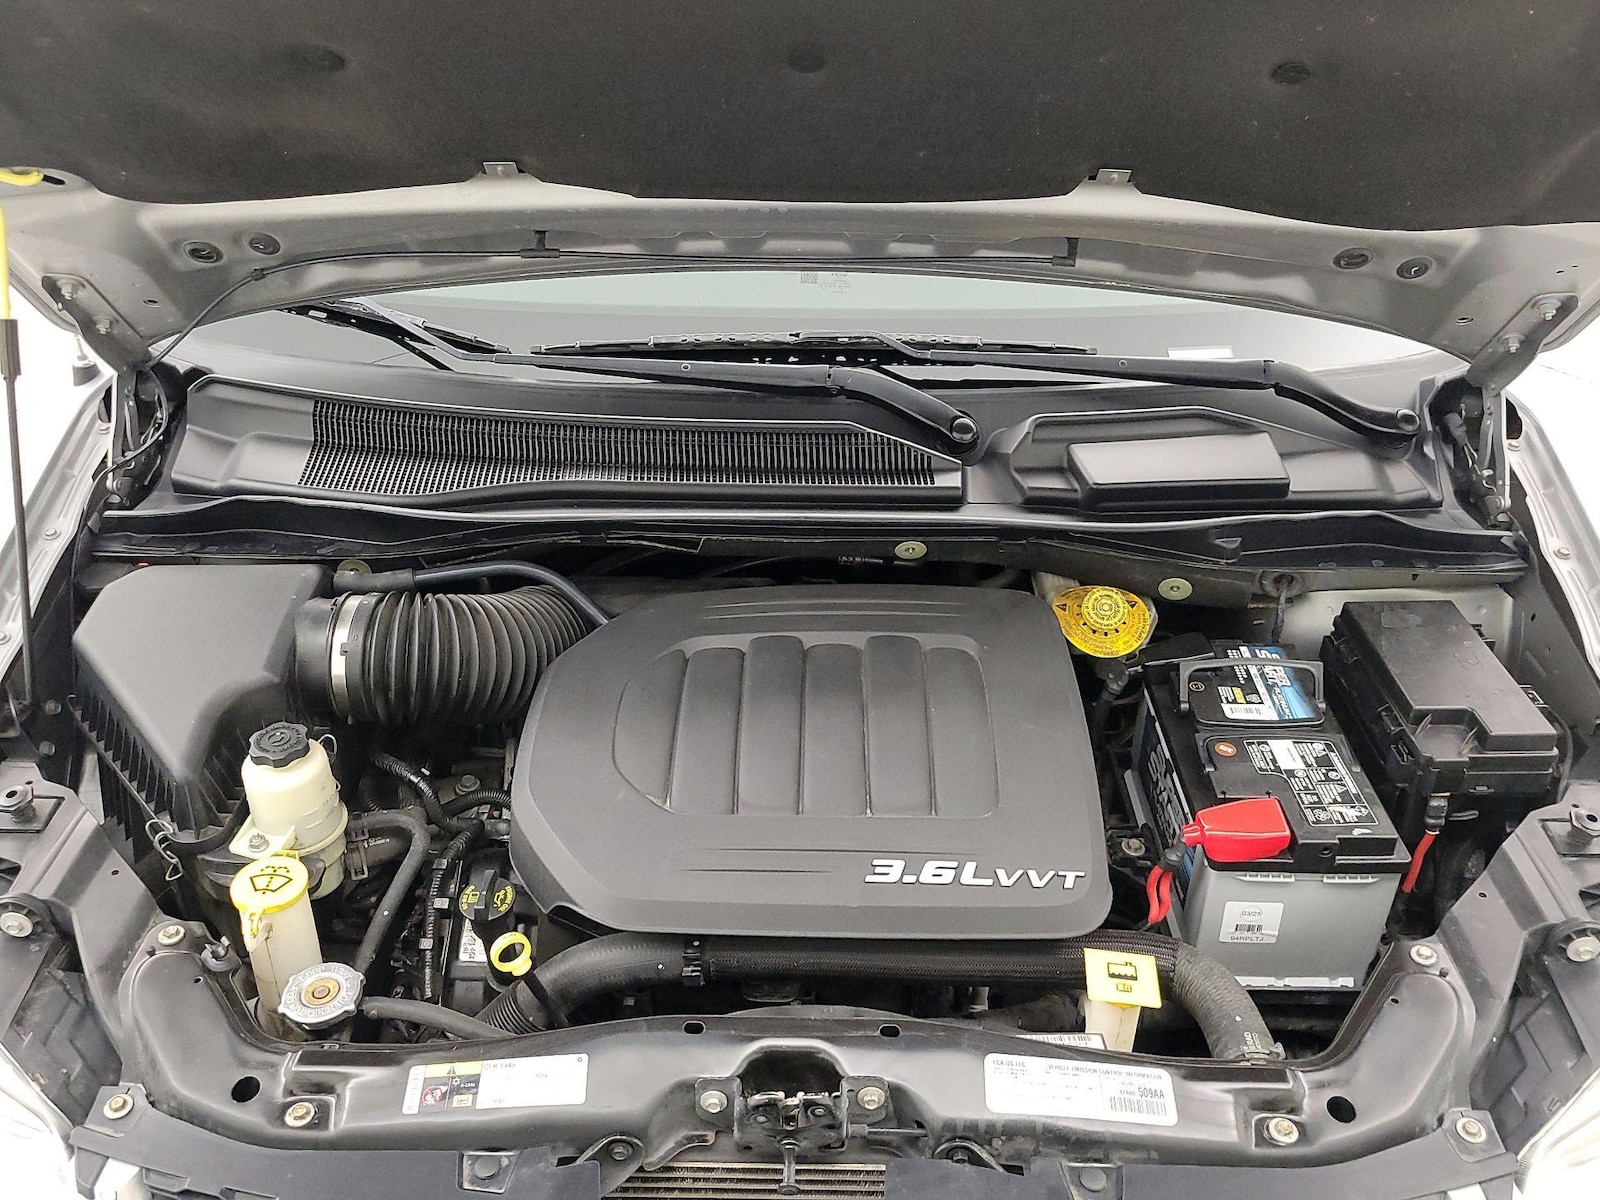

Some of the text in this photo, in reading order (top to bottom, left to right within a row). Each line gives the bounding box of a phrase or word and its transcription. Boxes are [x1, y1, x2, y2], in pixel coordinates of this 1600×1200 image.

[1240, 910, 1263, 918] 03/25
[1071, 1066, 1098, 1075] EMISSION
[1098, 1068, 1123, 1077] CONTROL
[1137, 1086, 1165, 1100] 509AA
